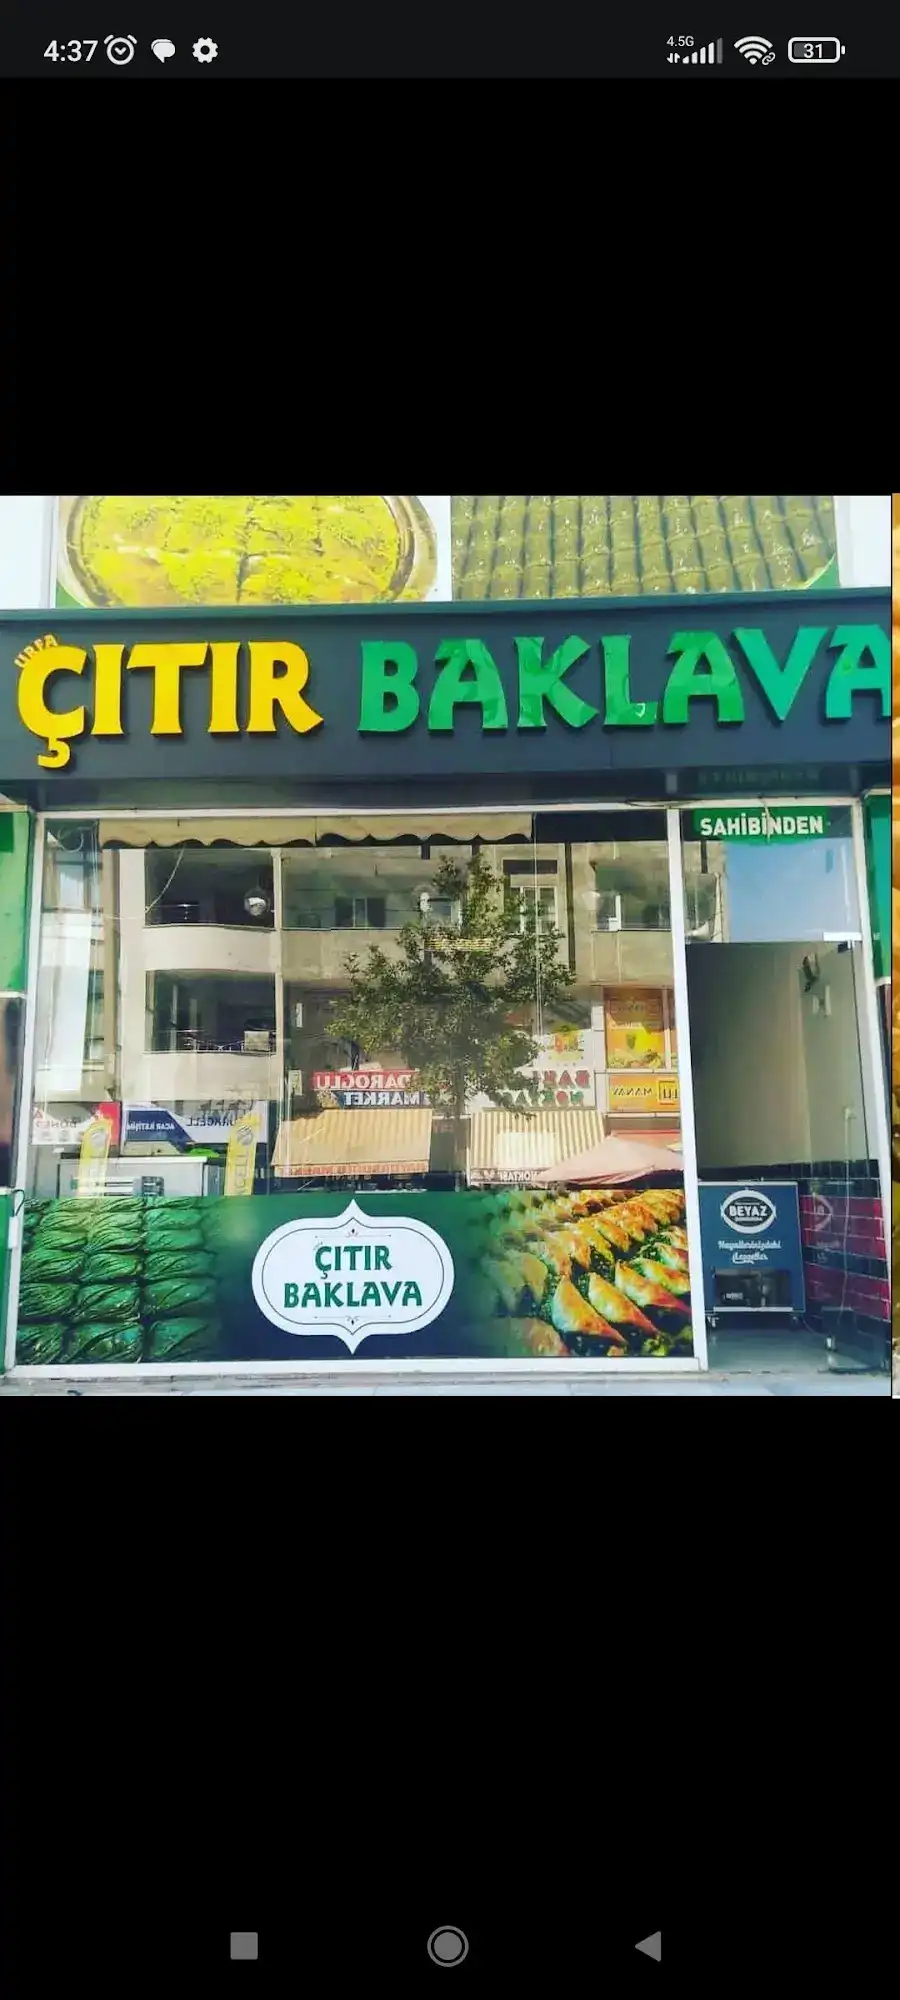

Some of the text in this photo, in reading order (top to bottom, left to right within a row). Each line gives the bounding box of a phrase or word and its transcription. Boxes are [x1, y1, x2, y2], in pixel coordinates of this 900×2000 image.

[17, 624, 891, 769] ÇITIR BAKLAVA
[700, 812, 824, 836] SAHİBİNDEN
[728, 1205, 768, 1217] BEYAZ
[315, 1245, 393, 1280] ÇITIR
[283, 1280, 423, 1309] BAKLAVA
